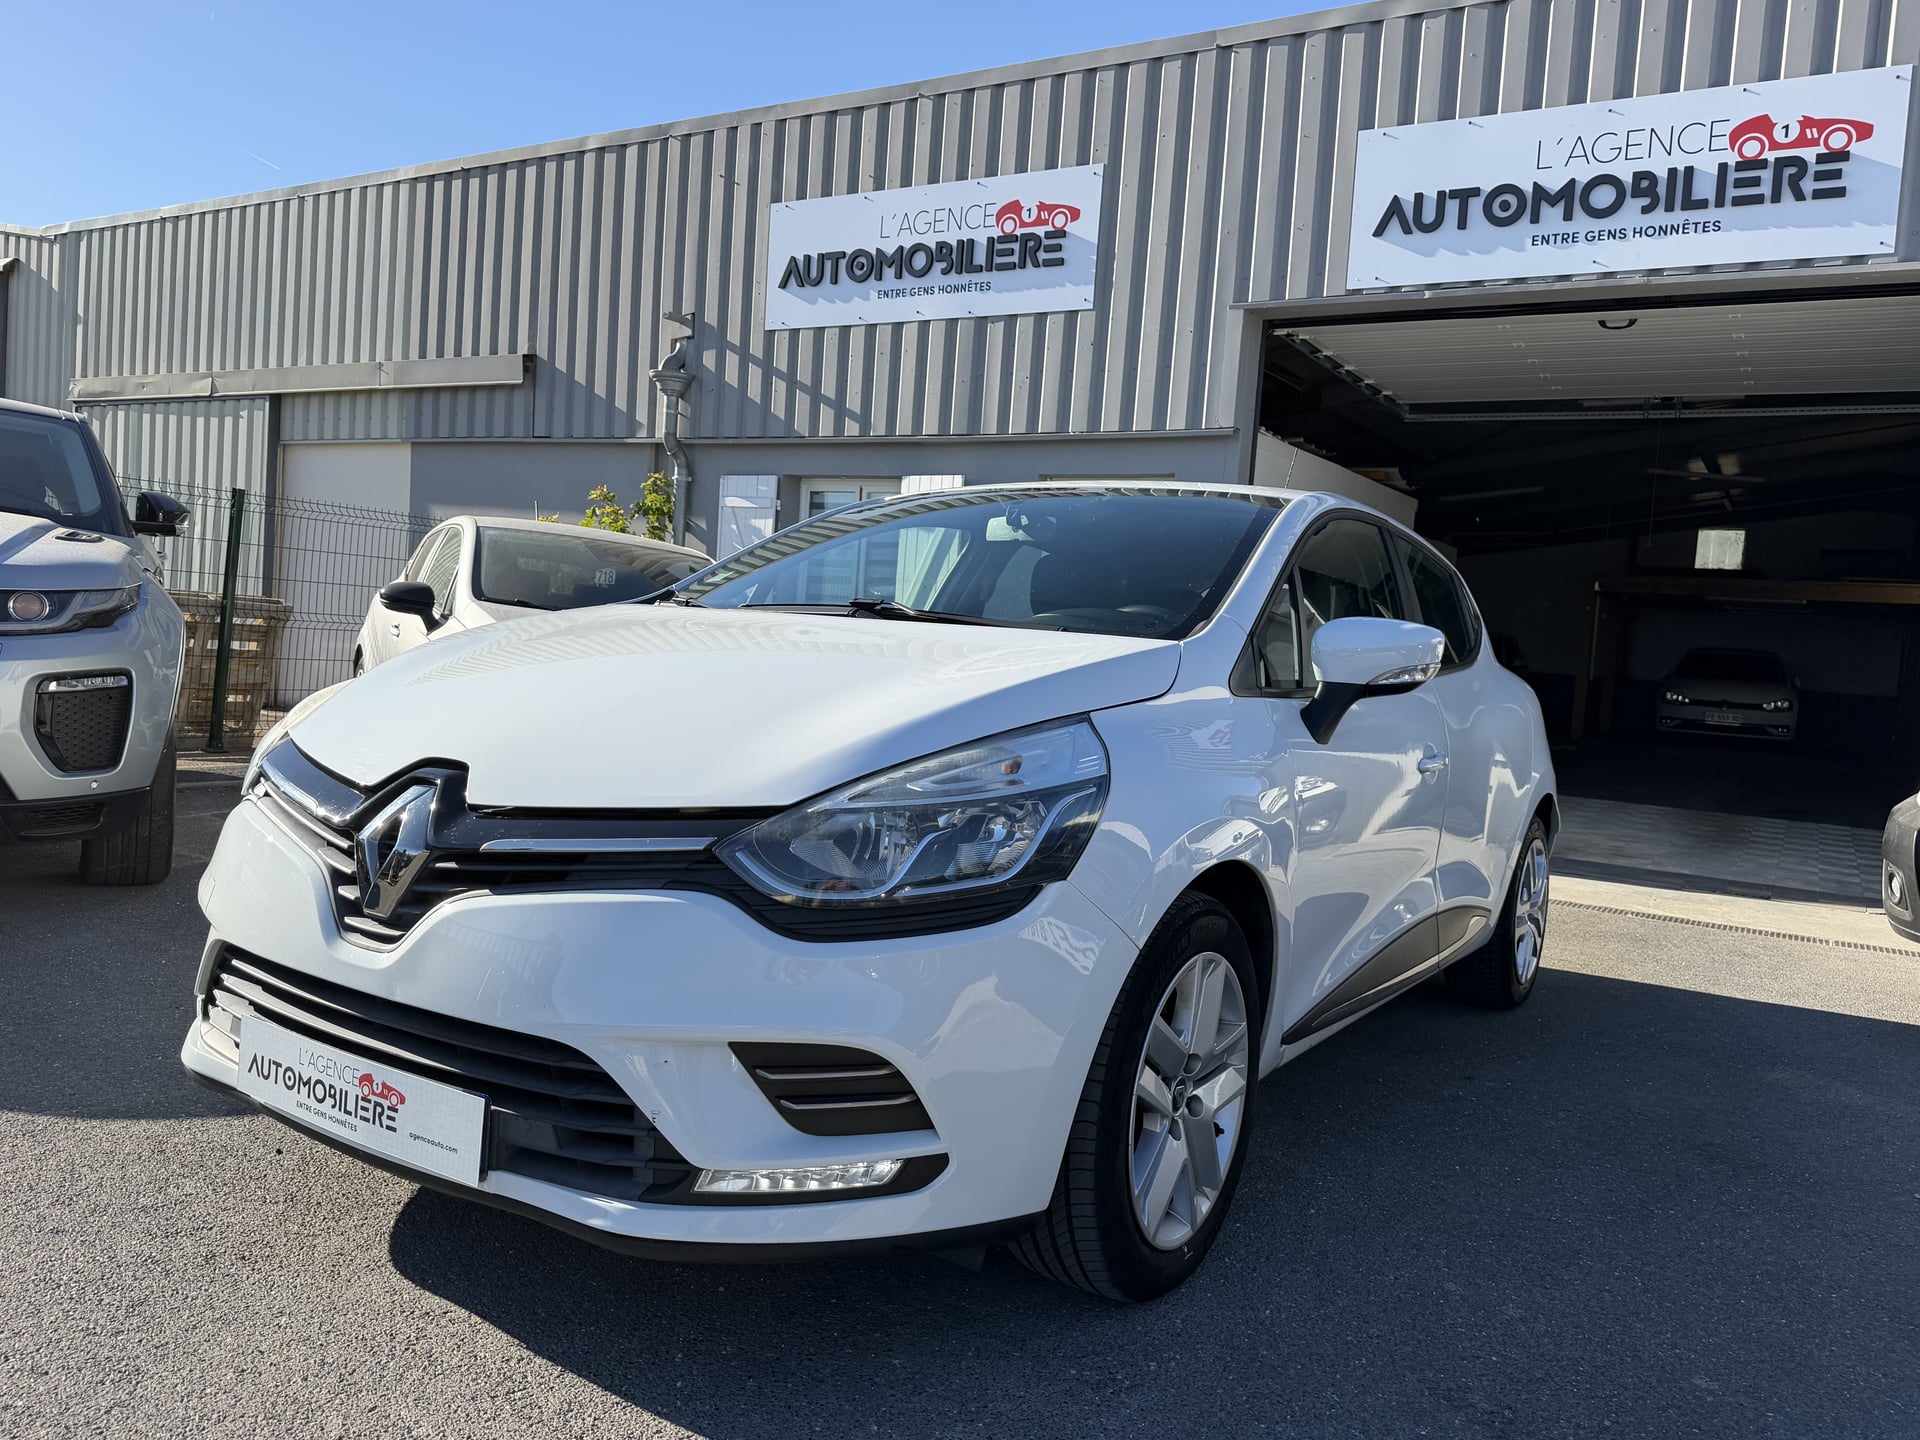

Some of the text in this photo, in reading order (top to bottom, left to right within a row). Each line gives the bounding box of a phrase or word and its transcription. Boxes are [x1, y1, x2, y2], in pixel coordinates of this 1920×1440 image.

[1535, 118, 1731, 170] L'AGENCE
[1781, 123, 1791, 140] 1
[879, 202, 997, 239] L'AGENCE
[1531, 218, 1722, 246] ENTRE GENS HONNÊTES
[877, 279, 992, 299] ENTRE GENS HONNÊTES
[597, 569, 614, 584] 718
[296, 1100, 358, 1132] ENTRE GENS HONNÊTES
[408, 1132, 458, 1154] agenceauto.com
